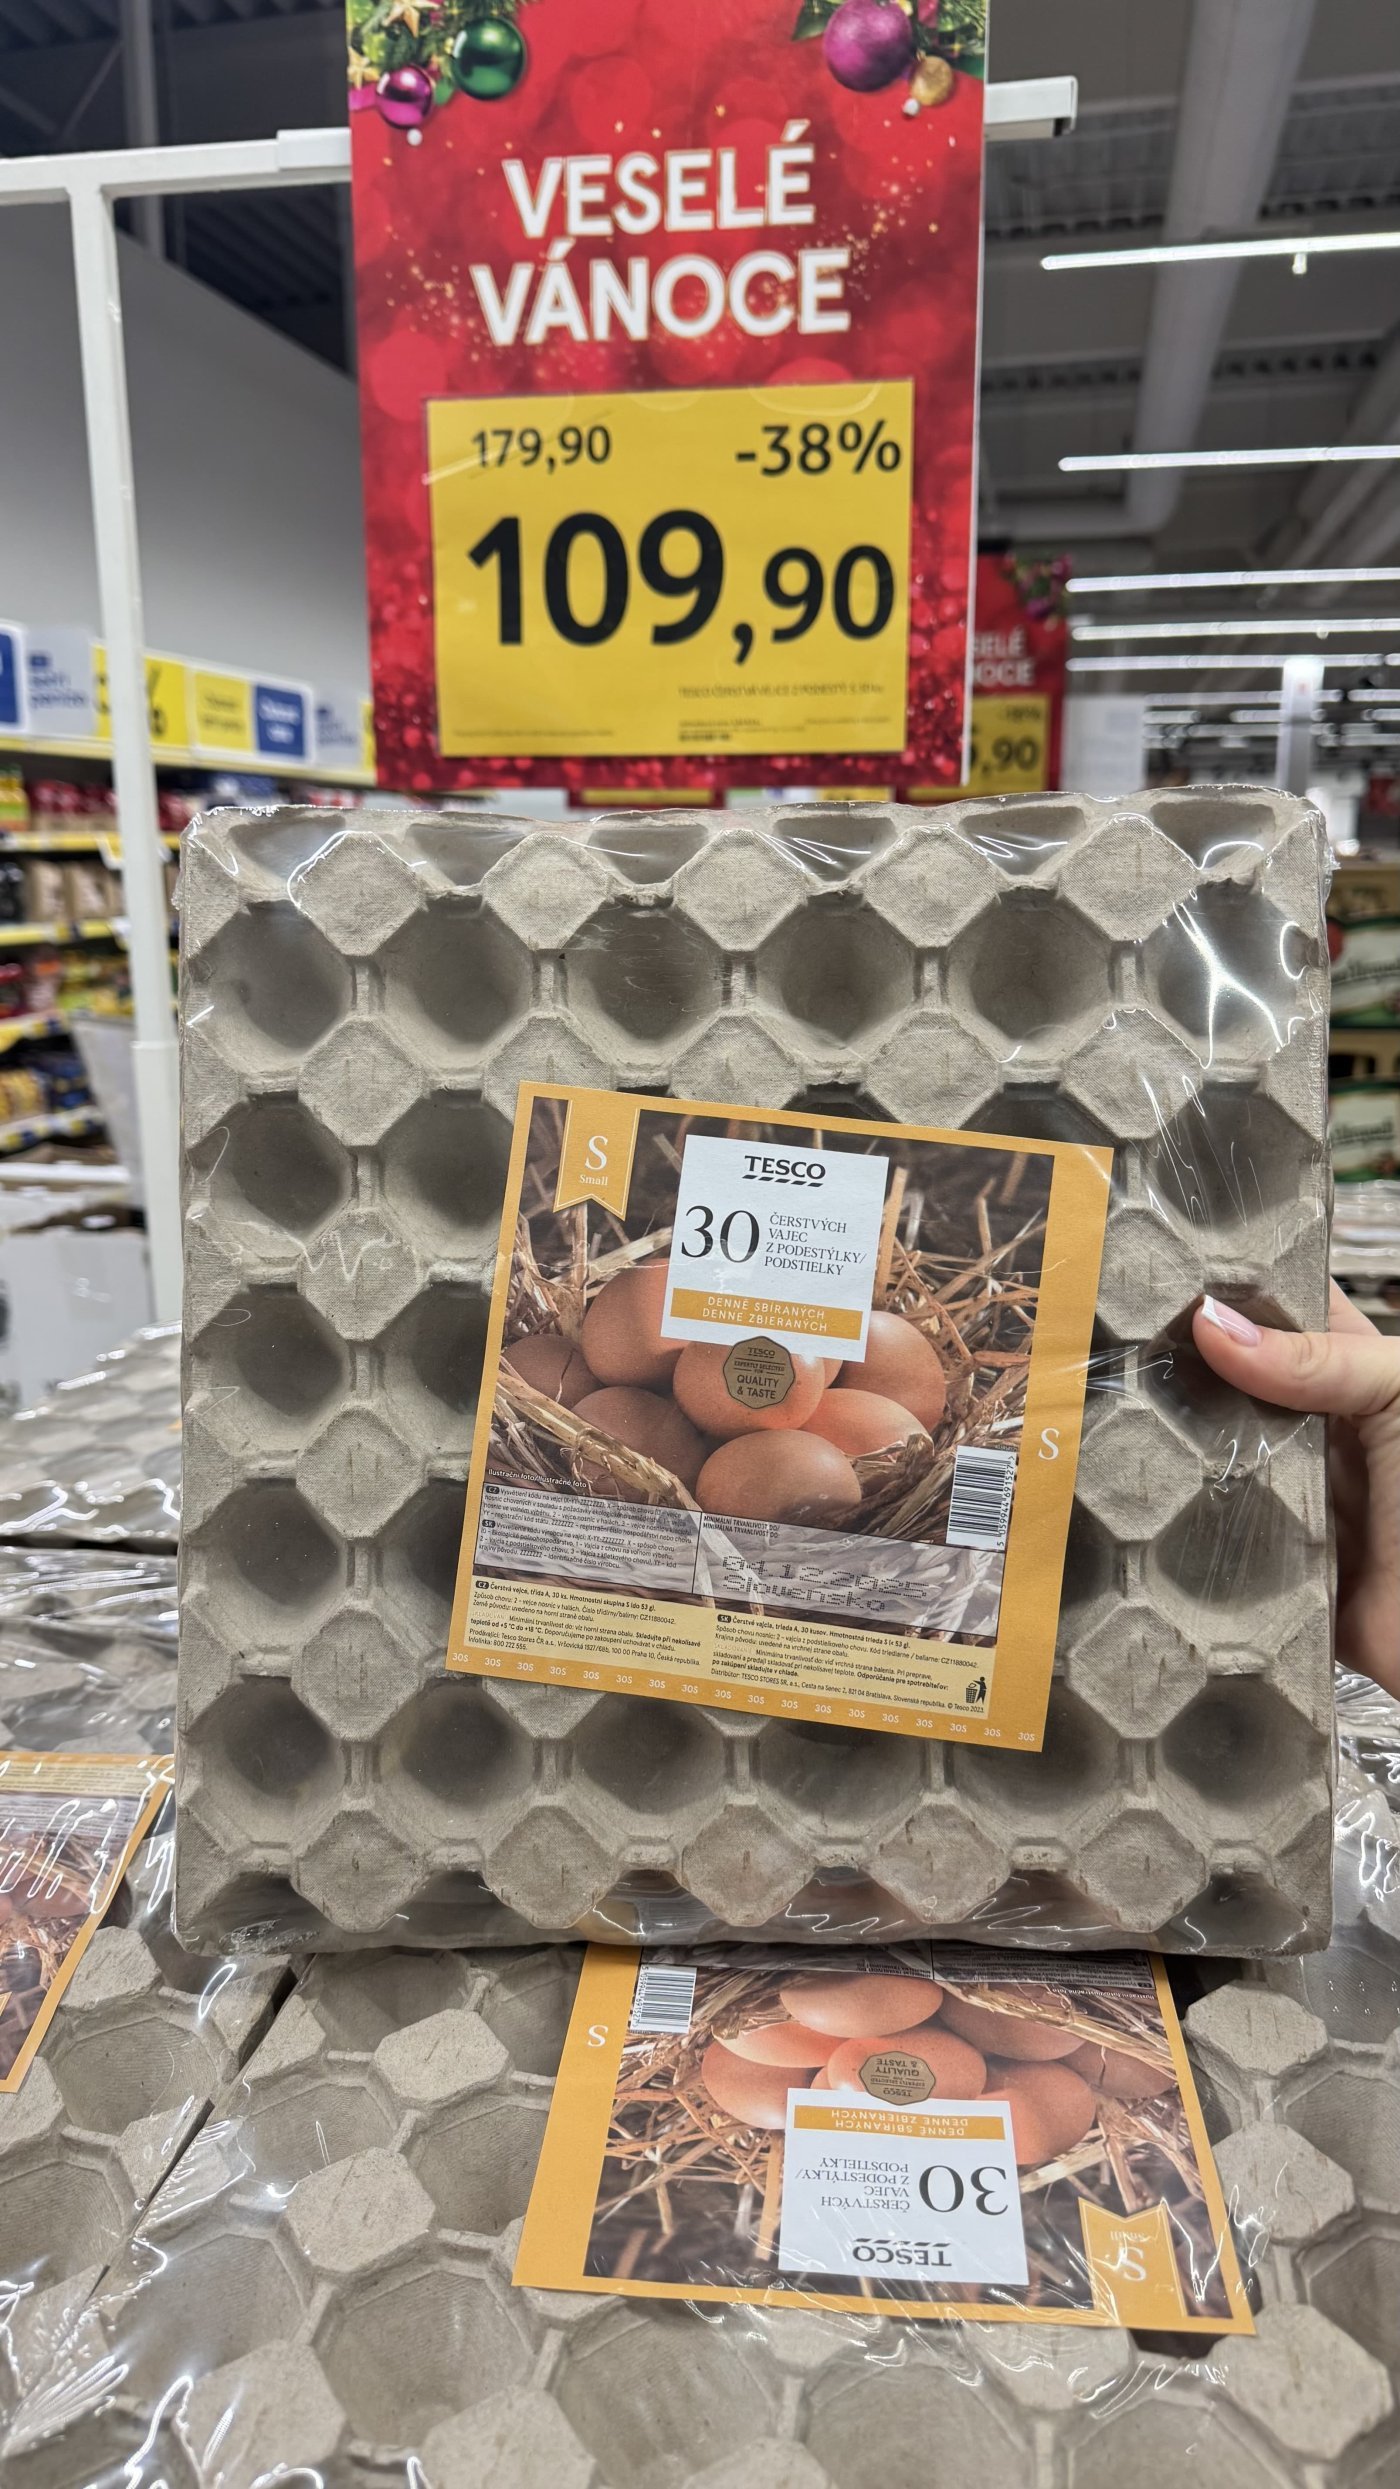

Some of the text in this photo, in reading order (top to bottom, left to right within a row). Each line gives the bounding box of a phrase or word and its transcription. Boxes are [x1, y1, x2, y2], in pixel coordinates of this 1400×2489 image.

[502, 119, 816, 239] VESELÉ
[469, 238, 852, 346] VÁNOCE
[471, 420, 902, 479] 179,90 -38%
[467, 507, 897, 666] 109,90
[584, 1134, 610, 1171] S
[742, 1154, 827, 1180] TESCO
[577, 1173, 609, 1186] Small
[768, 1210, 848, 1233] ČERSTVÝCH
[679, 1203, 762, 1265] 30
[766, 1227, 809, 1243] VAJEC
[764, 1240, 866, 1265] Z PODESTÝLKY/
[763, 1255, 844, 1276] PODSTIELKY
[706, 1294, 825, 1319] DENNĚ SBÍRANÝCH
[701, 1307, 828, 1332] DENNE ZBIERANÝCH
[746, 1346, 776, 1357] TESCO
[733, 1359, 785, 1372] EXPERTLY SELECTED
[735, 1373, 780, 1388] QUALITY
[735, 1385, 777, 1399] & TASTE
[1037, 1427, 1062, 1461] S
[487, 1467, 520, 1479] Ilustrační
[572, 1479, 587, 1488] foto
[1001, 1463, 1015, 1498] 691527
[731, 1518, 769, 1530] TRVANLIVOST
[997, 1501, 1010, 1535] 059944
[451, 1652, 1035, 1742] 30S 30S 30S 30S 30S 30S 30S 30S 30S 30S 30S 30S 30S 30S 30S 30S 30S 30S
[587, 2023, 609, 2049] S
[875, 2066, 920, 2077] QUALITY
[876, 2058, 908, 2068] TASTE
[883, 2090, 912, 2098] TESCO
[830, 2109, 969, 2127] DENNE ZBIERANÝCH
[835, 2119, 966, 2137] DENNĚ SBÍRANÝCH
[819, 2157, 909, 2173] PODSTIELKY
[794, 2168, 910, 2185] Z PODESTÝLKY/
[863, 2185, 910, 2198] VAJEC
[918, 2164, 1009, 2216] 30
[820, 2195, 911, 2213] ČERSTVÝCH
[852, 2245, 952, 2267] TESCO
